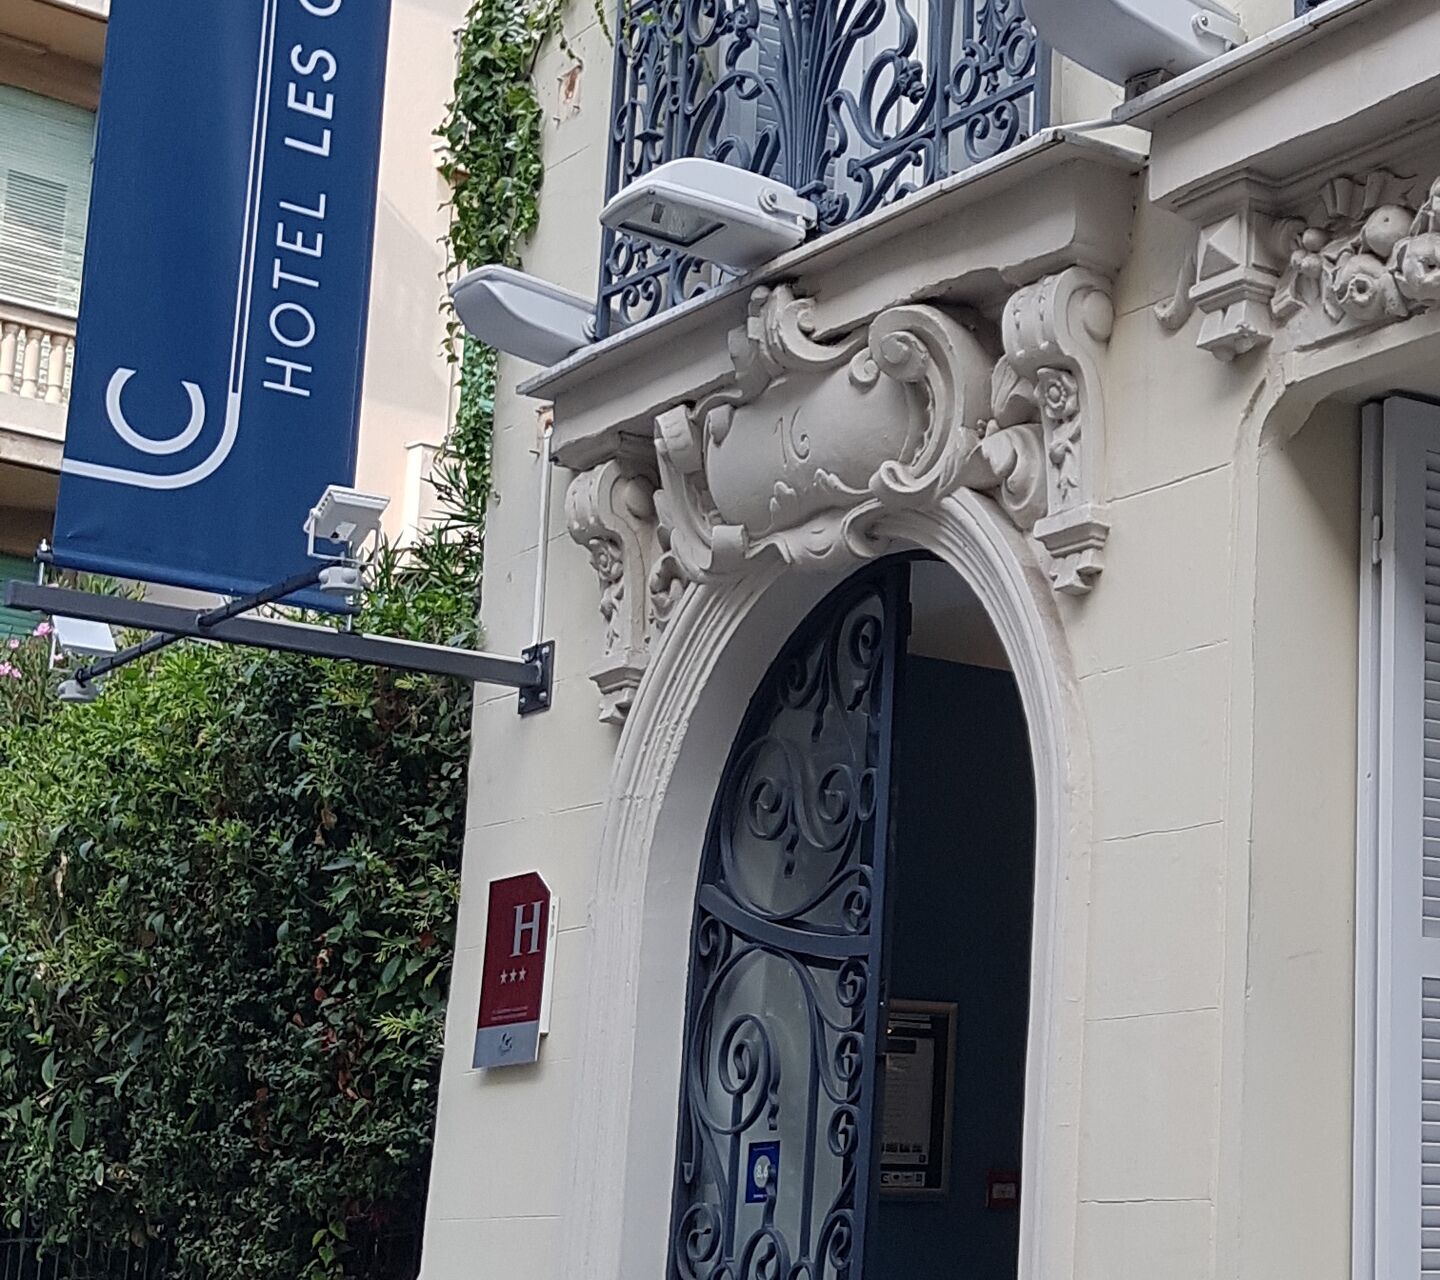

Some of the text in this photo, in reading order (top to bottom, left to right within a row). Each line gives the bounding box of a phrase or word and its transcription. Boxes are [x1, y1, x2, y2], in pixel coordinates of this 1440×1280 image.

[284, 43, 337, 157] LES
[263, 192, 327, 397] HOTEL
[509, 899, 545, 958] H
